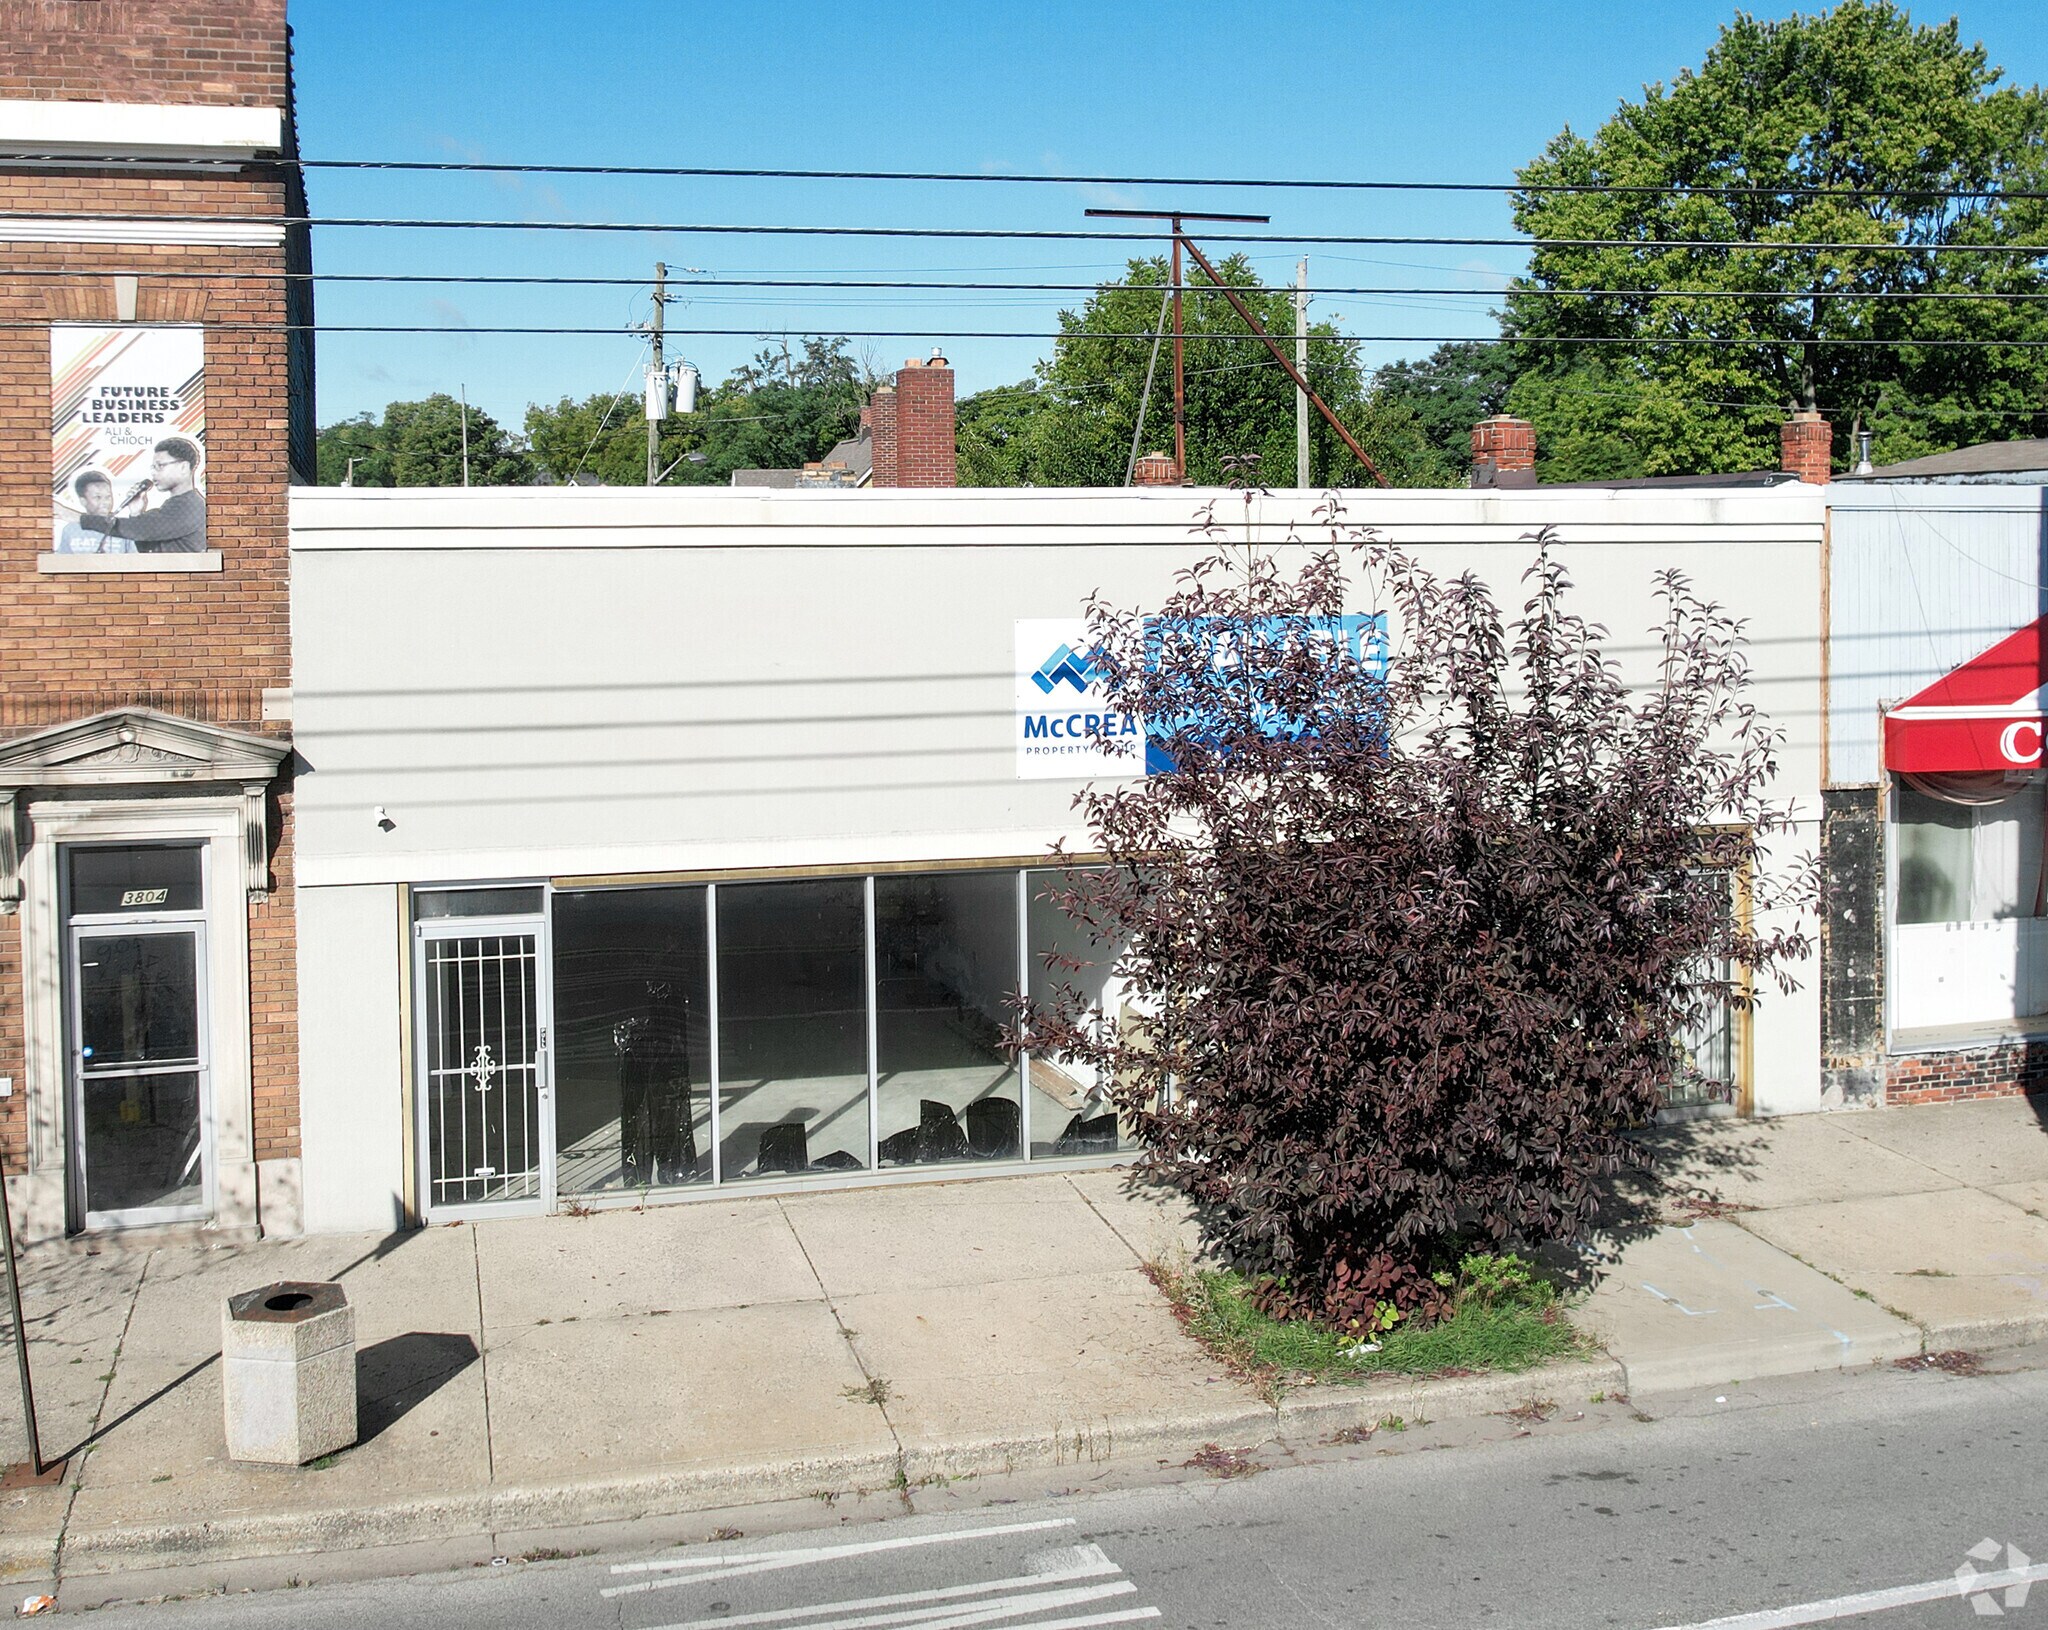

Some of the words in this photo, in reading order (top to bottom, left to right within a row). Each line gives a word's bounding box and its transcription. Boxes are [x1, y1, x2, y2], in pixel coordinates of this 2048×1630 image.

[101, 386, 169, 398] FUTURE
[92, 399, 179, 411] BUSINESS
[82, 412, 164, 423] LEADERS
[105, 427, 122, 436] ALI
[124, 426, 133, 436] &
[110, 436, 153, 445] CHIOCH
[1024, 714, 1137, 738] McCREA
[2000, 721, 2048, 764] C
[1026, 746, 1089, 755] PROPERTY
[1096, 744, 1136, 754] GOUP
[124, 890, 166, 904] 3804
